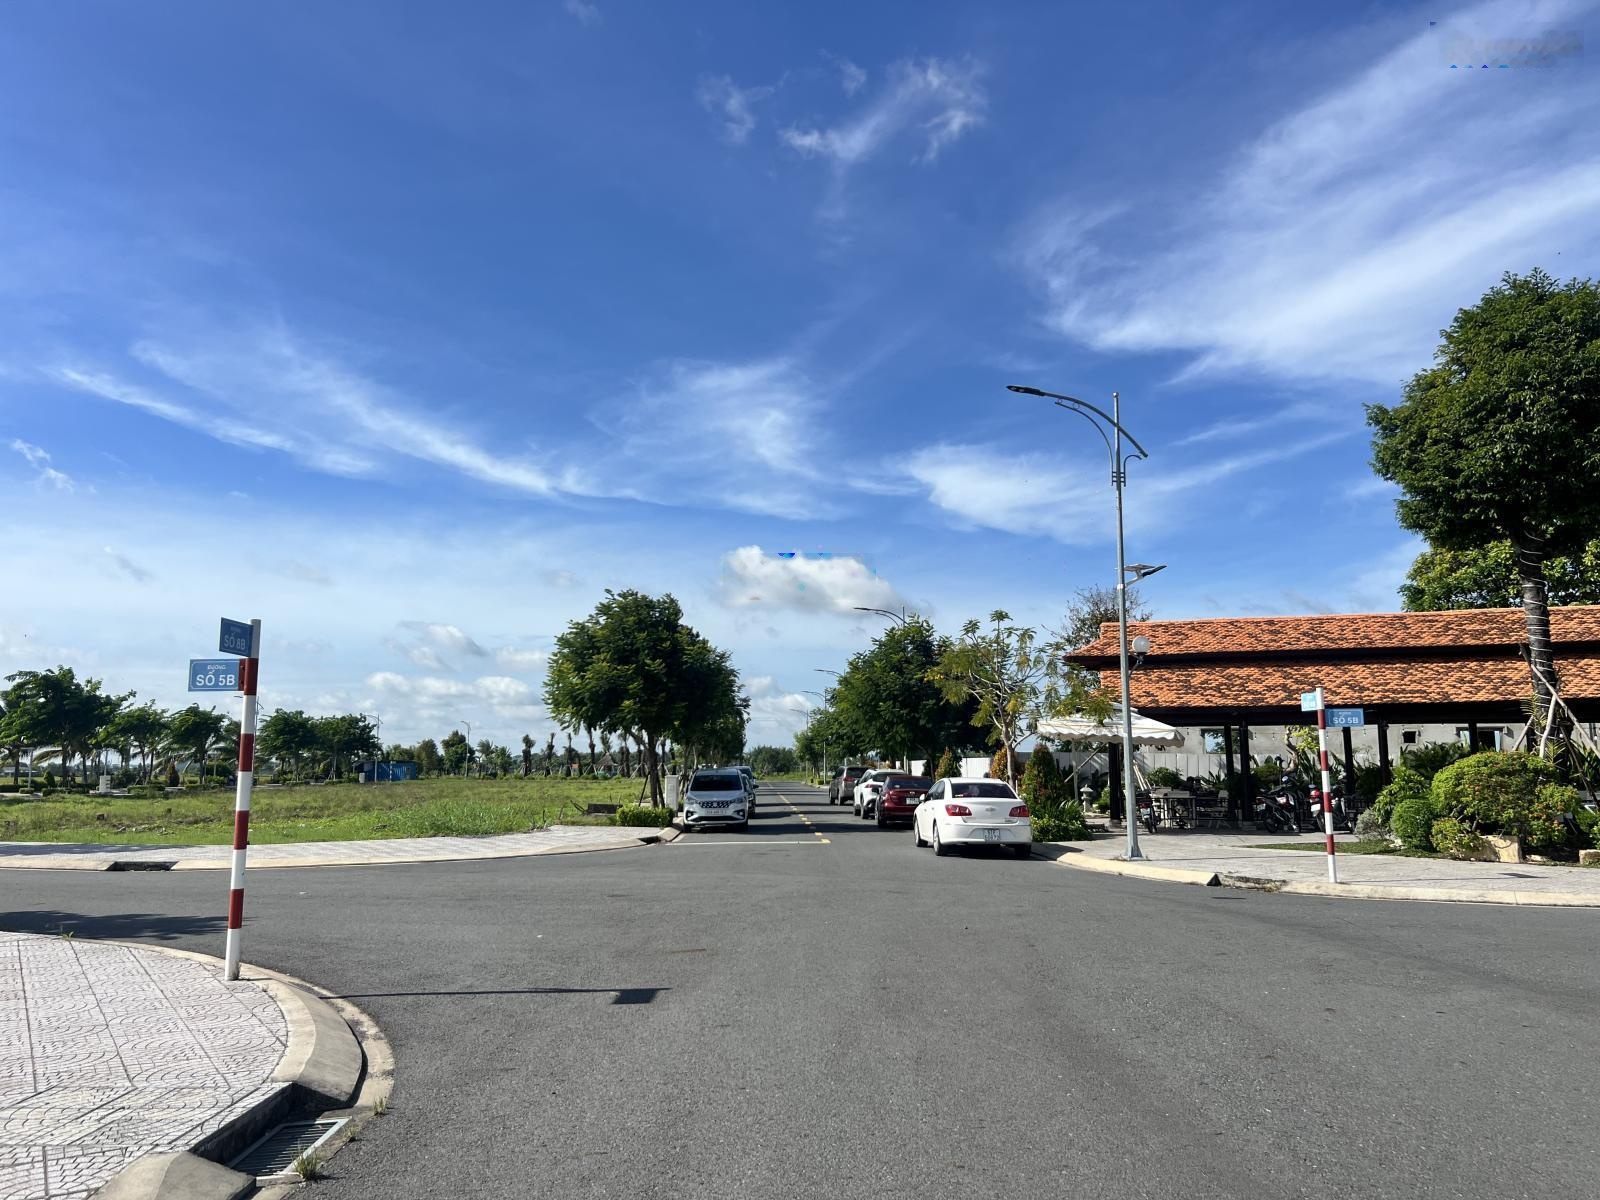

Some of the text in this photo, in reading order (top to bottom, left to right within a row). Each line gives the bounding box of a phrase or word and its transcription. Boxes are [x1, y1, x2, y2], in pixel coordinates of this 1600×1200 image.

[196, 670, 235, 686] SỐ 5B
[1333, 713, 1346, 724] SỐ
[1347, 716, 1359, 724] 5B
